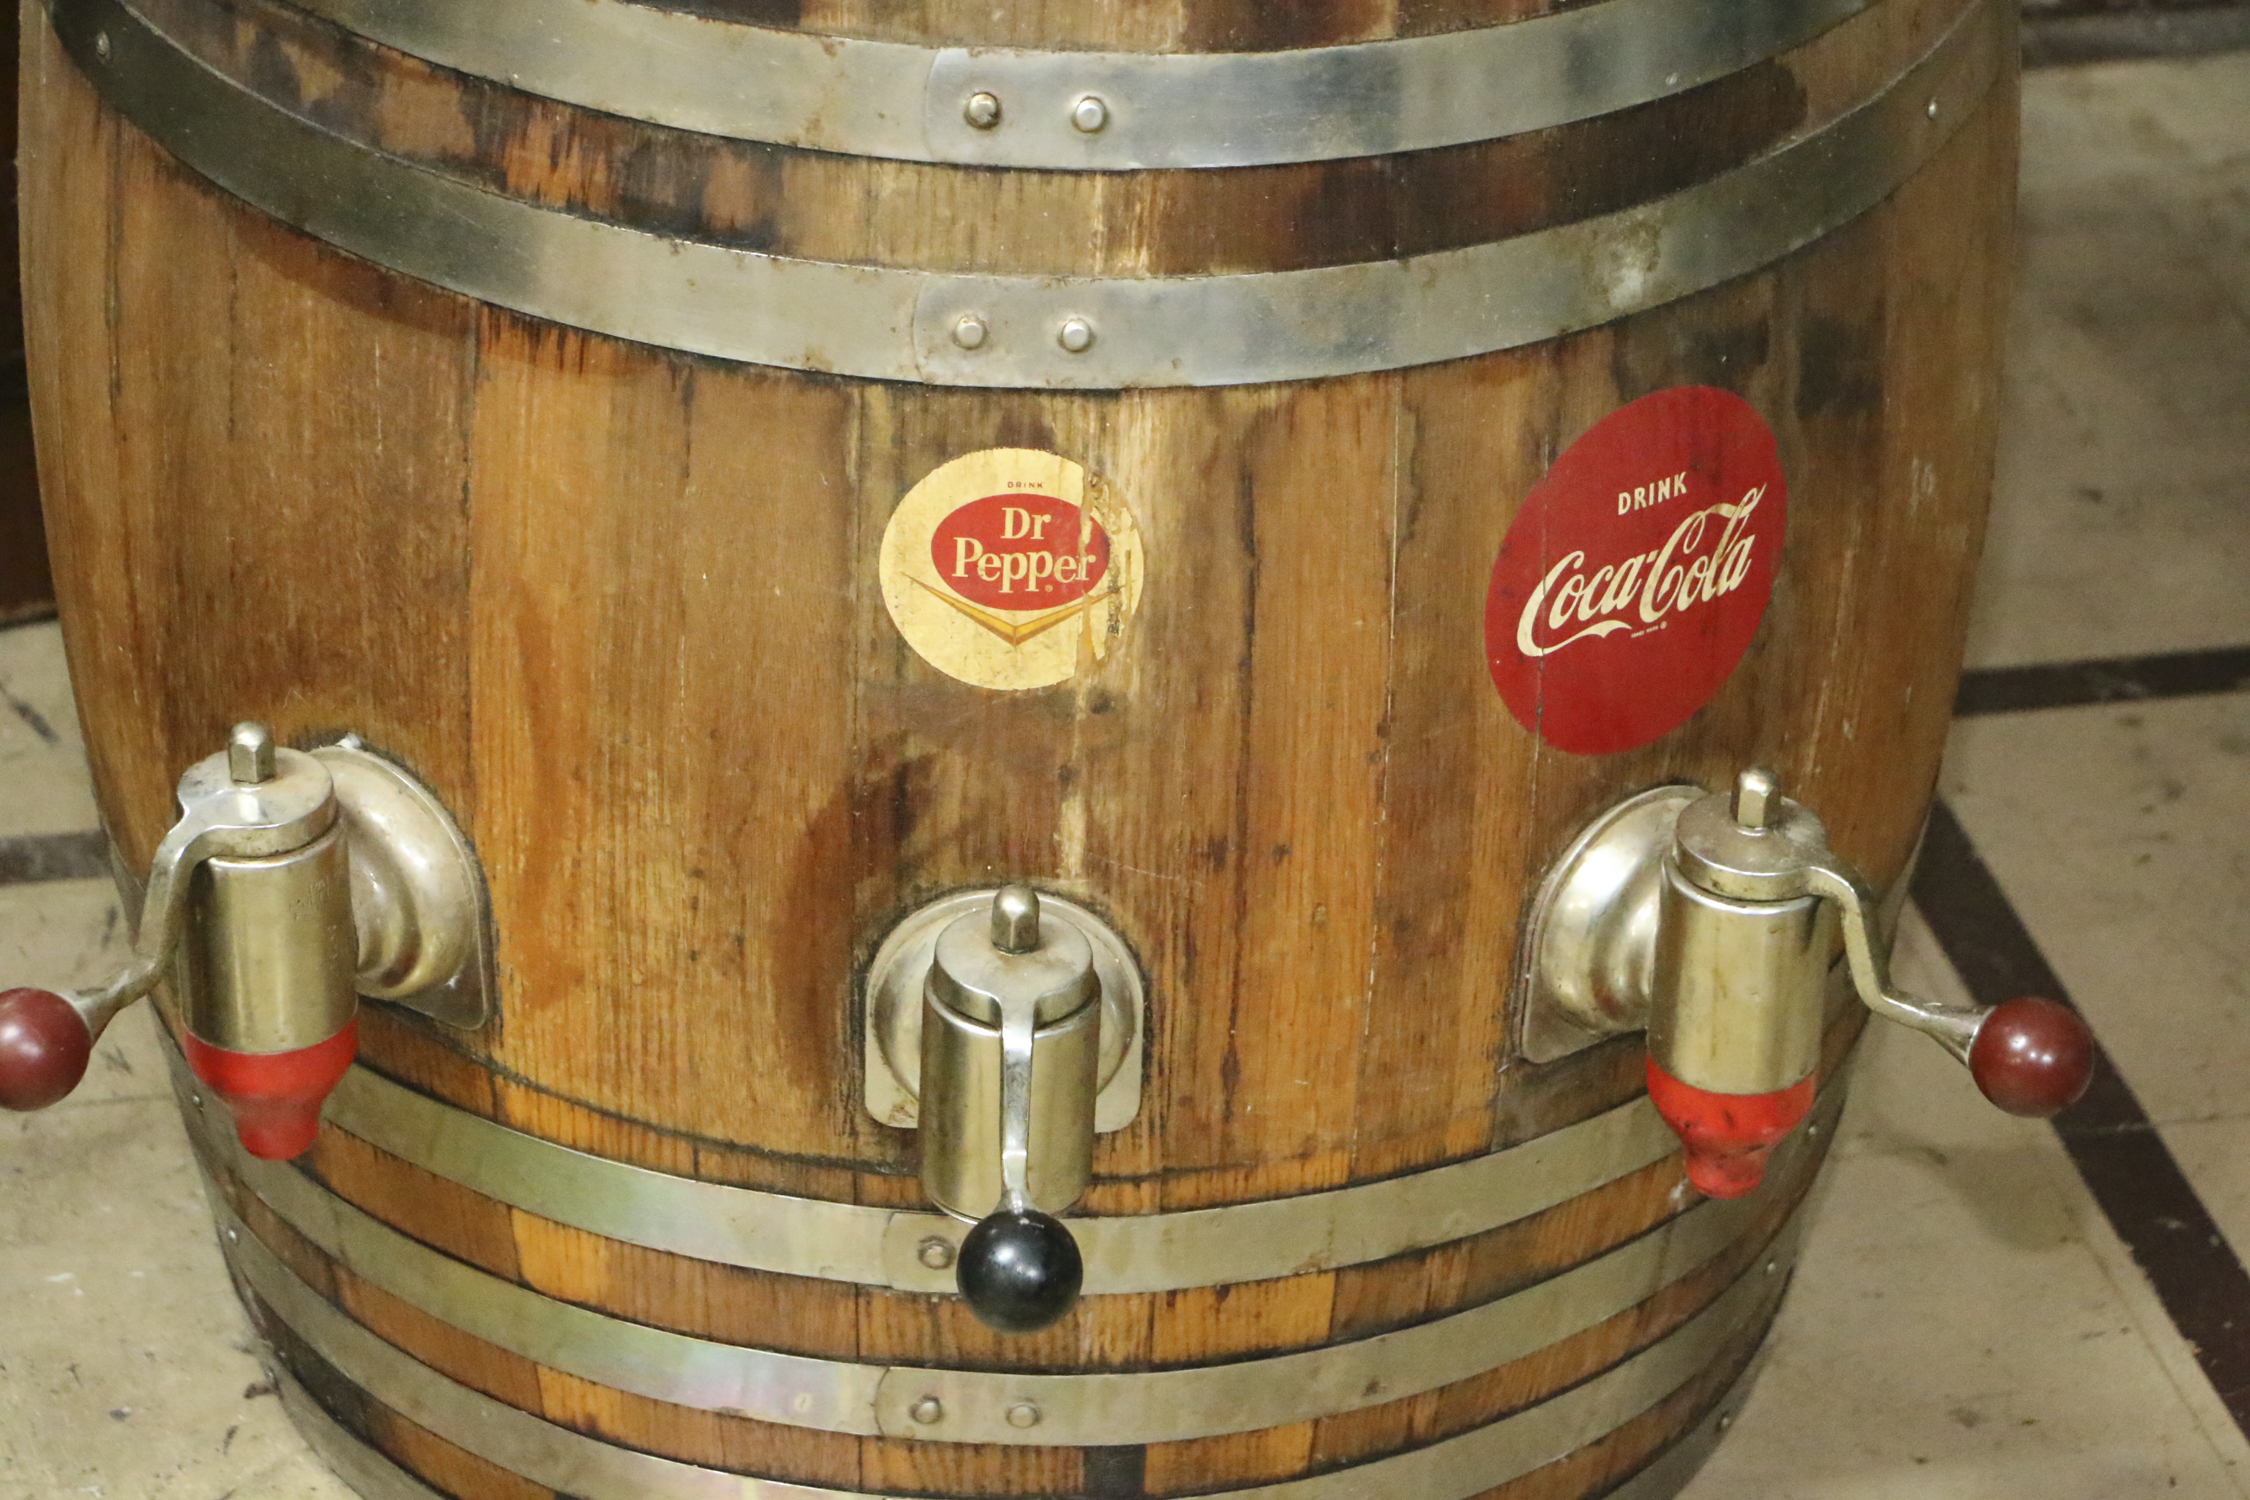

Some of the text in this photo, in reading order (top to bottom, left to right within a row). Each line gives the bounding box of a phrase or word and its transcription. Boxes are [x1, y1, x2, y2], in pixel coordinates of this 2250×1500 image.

[1007, 481, 1043, 489] DRINK
[1618, 471, 1687, 515] DRINK
[1001, 507, 1051, 540] Dr
[952, 537, 1097, 593] Pepper
